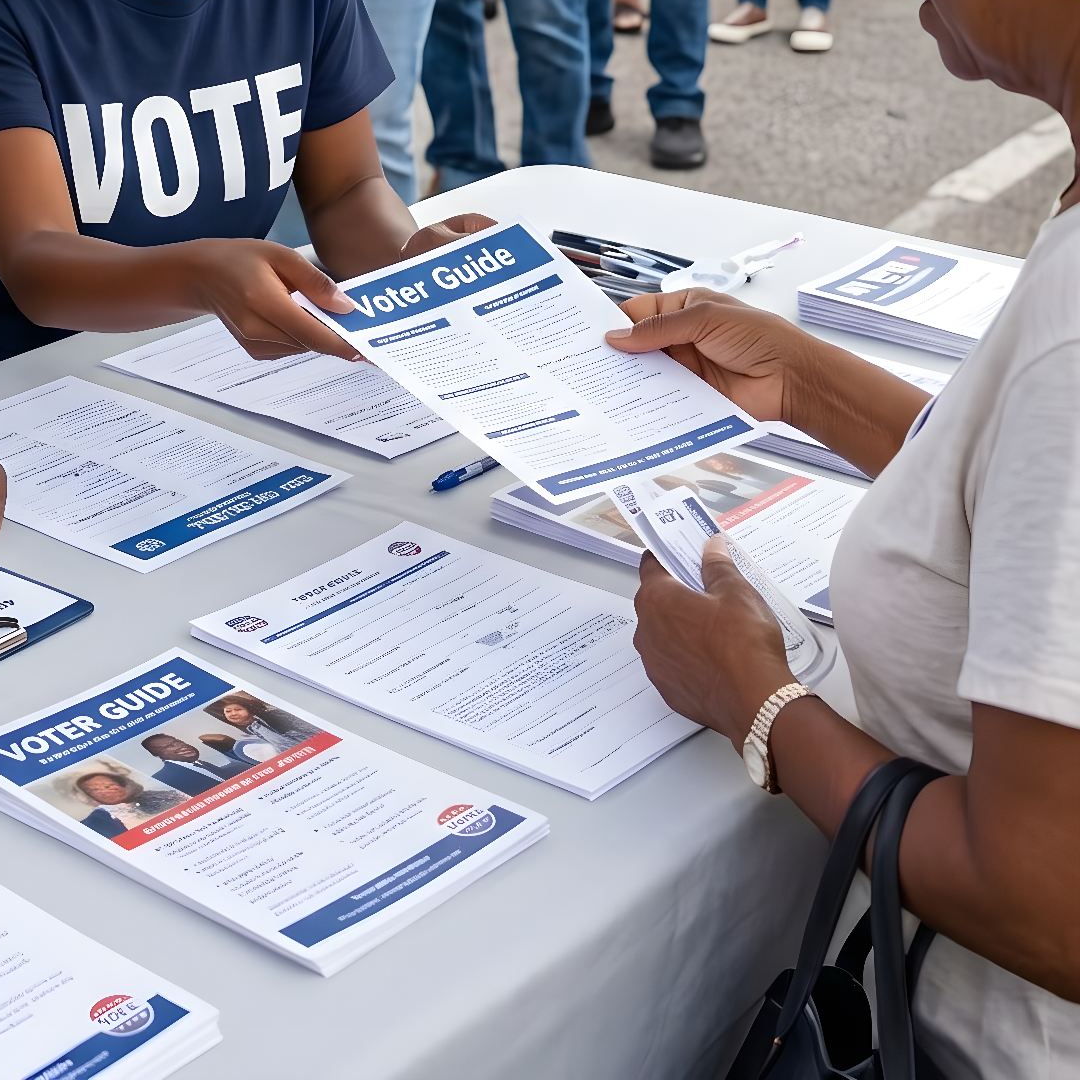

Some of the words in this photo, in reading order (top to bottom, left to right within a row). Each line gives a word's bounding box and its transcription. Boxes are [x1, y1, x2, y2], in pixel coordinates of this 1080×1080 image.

[62, 63, 303, 223] VOTE
[355, 280, 429, 319] Voter
[431, 245, 517, 291] Guide
[98, 672, 192, 721] GUIDE
